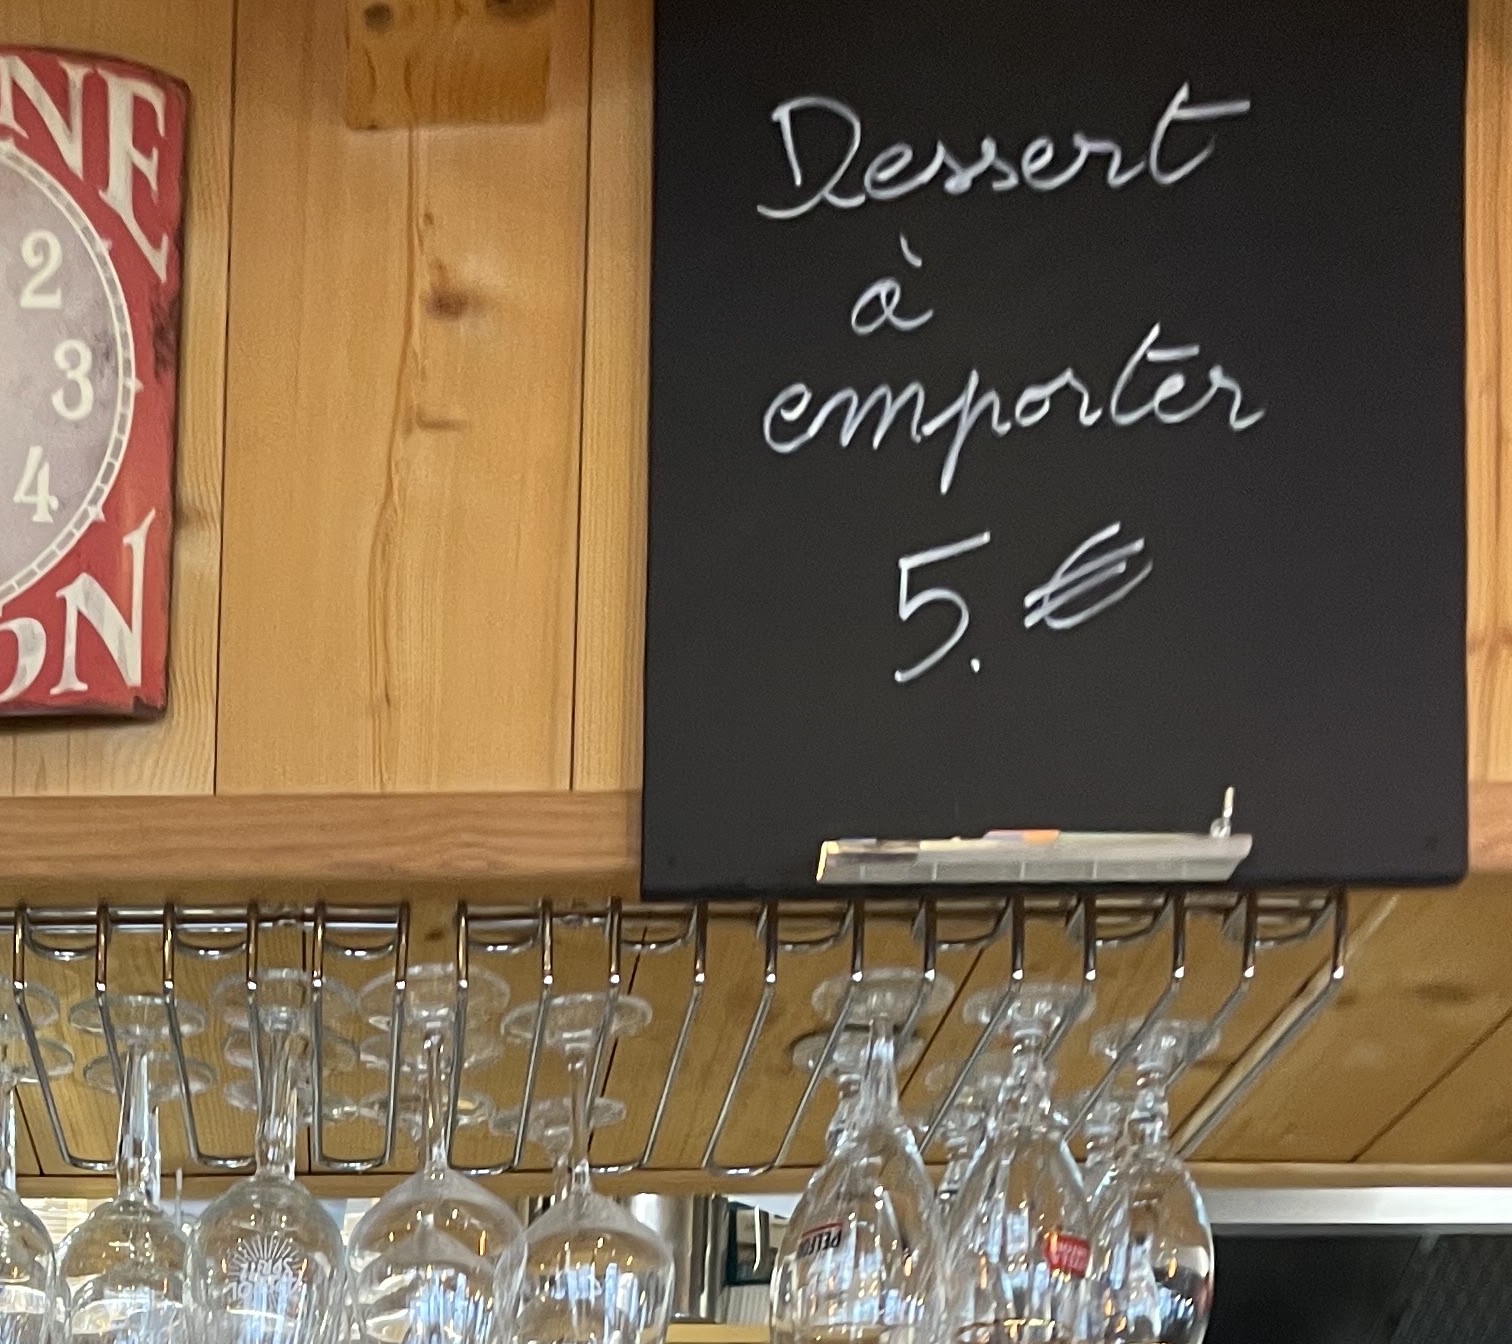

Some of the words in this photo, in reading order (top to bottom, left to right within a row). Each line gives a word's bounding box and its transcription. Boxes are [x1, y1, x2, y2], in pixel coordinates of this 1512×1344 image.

[757, 81, 1251, 218] Dessert
[19, 230, 63, 309] 2
[851, 234, 934, 337] à
[50, 339, 94, 420] 3
[762, 323, 1268, 495] emporter
[14, 445, 59, 522] 4
